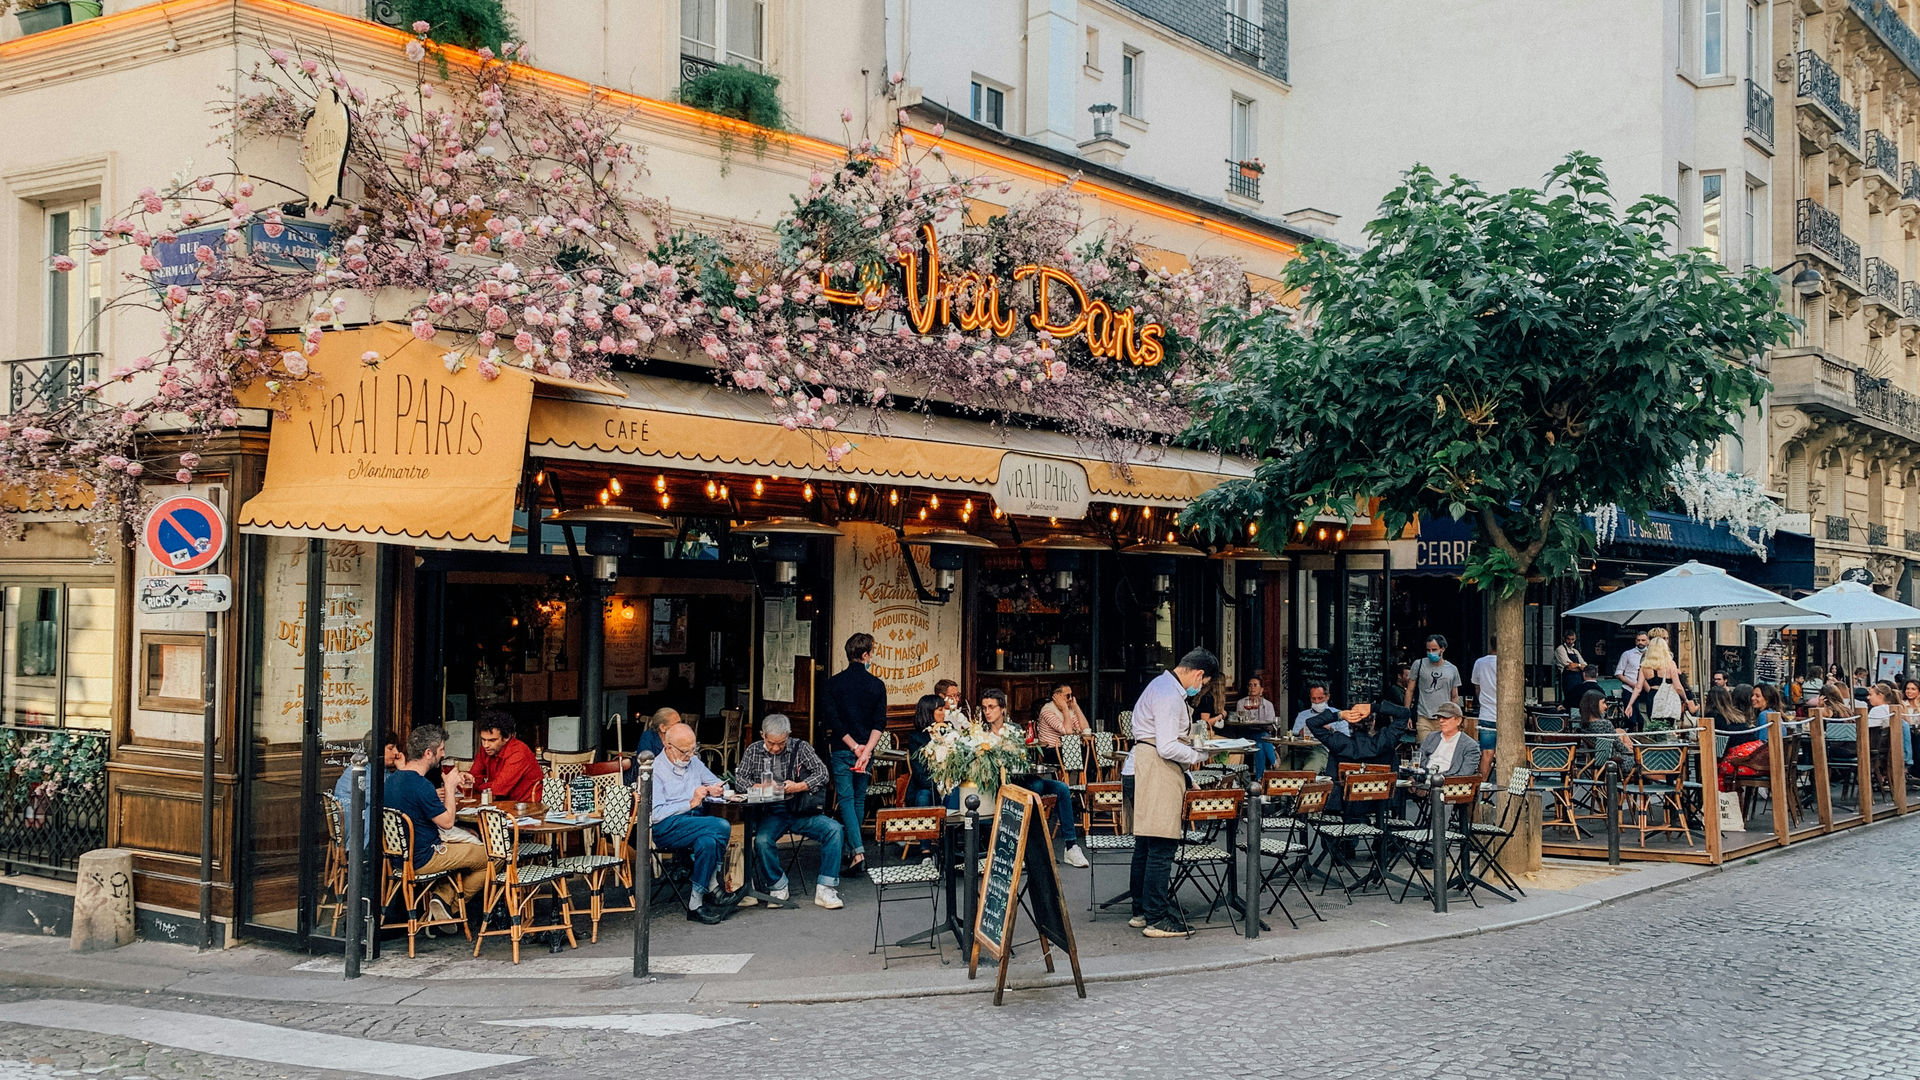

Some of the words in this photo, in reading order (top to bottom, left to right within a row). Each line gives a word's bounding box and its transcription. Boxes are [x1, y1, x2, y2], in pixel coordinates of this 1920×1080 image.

[287, 230, 318, 243] RUE
[179, 241, 200, 254] RUE
[898, 223, 1016, 337] Vrai
[309, 376, 380, 454] VRAI
[395, 374, 484, 455] PARIS
[605, 419, 649, 441] CAFÉ
[348, 459, 431, 480] Montmartre
[1006, 463, 1038, 499] VRAI
[1044, 463, 1079, 503] PARIS
[1628, 519, 1637, 537] LE
[147, 594, 172, 609] RICKS
[872, 613, 908, 633] PRODUITS
[909, 614, 930, 631] FRAIS
[897, 628, 905, 642] &
[872, 640, 893, 661] FAIT
[895, 640, 929, 662] MAISON
[906, 653, 941, 679] HEURE
